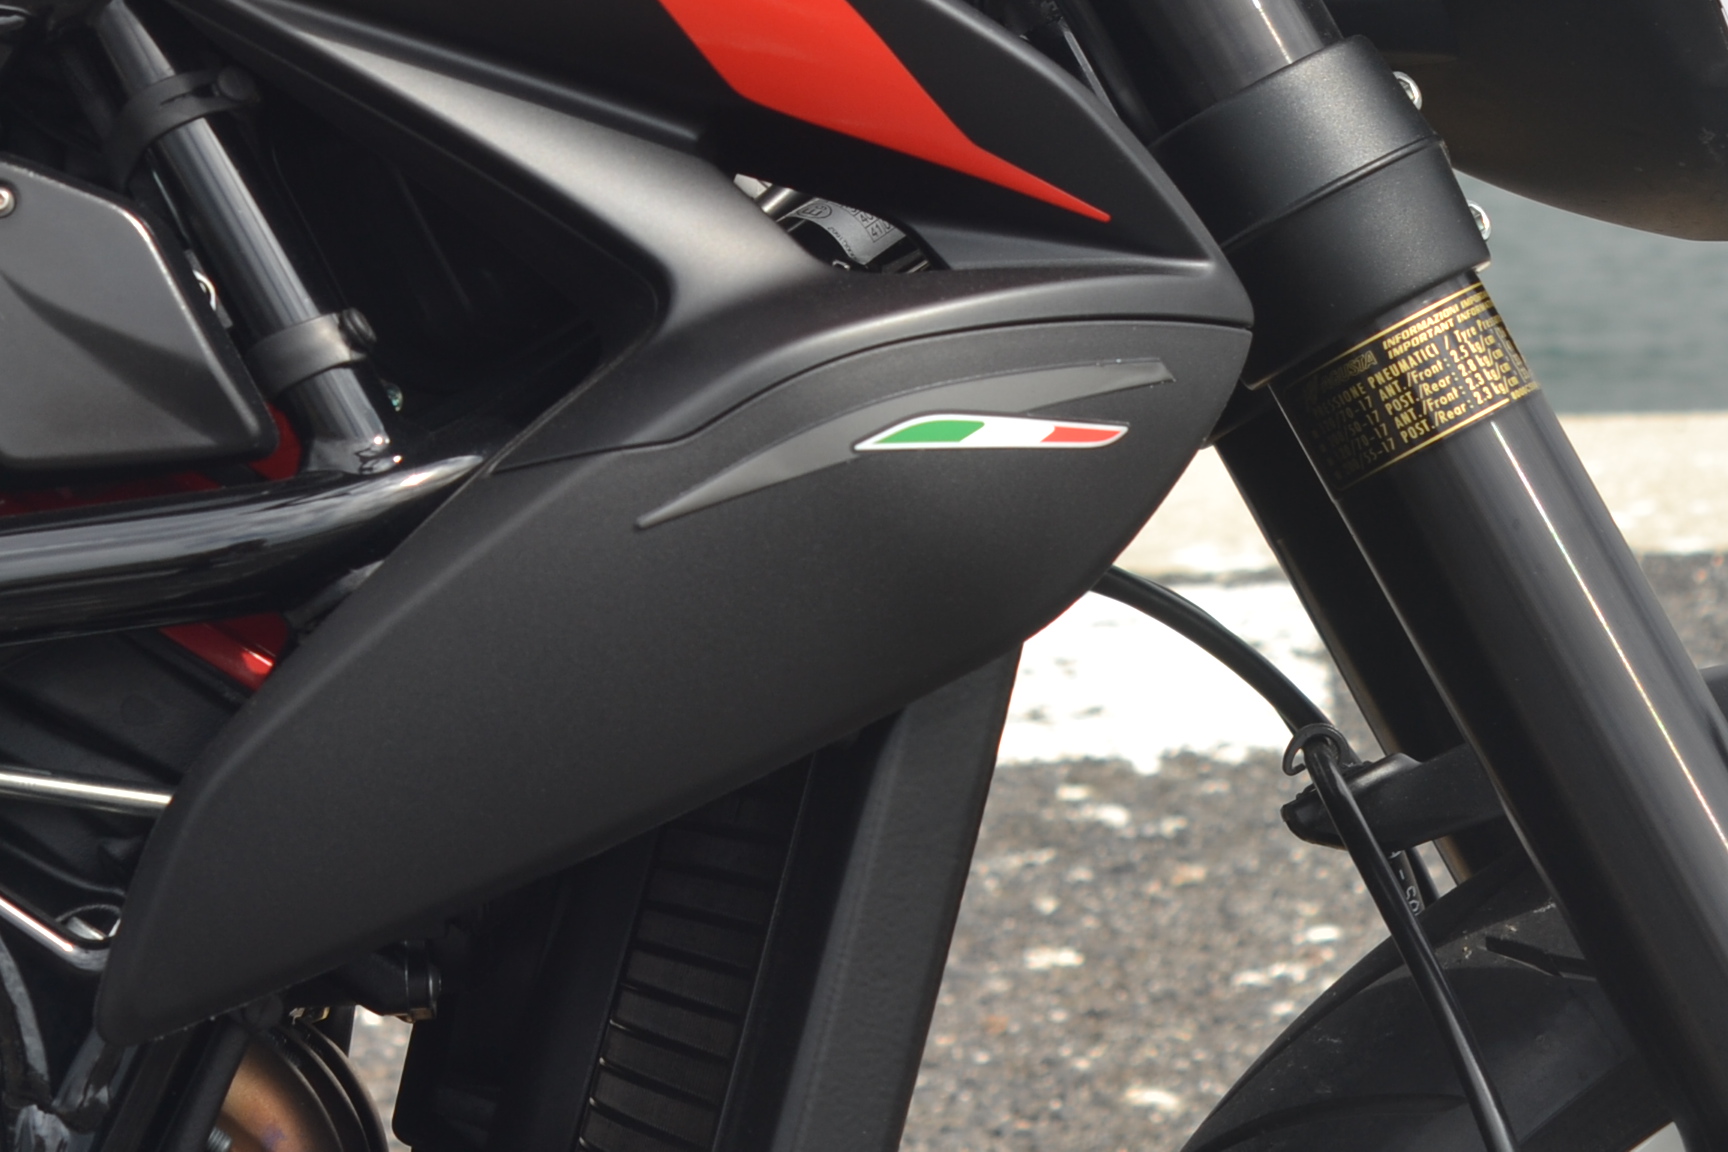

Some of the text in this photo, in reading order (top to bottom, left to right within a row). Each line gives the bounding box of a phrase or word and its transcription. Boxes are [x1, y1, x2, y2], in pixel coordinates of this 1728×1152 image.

[1380, 302, 1460, 350] INFORMAZIONI
[1385, 316, 1456, 360] IMPORTANT
[1364, 341, 1441, 390] PNEUMATICI
[1452, 321, 1480, 346] Tyre
[1447, 342, 1471, 364] 2.5
[1455, 356, 1479, 378] 2.8
[1463, 370, 1486, 392] 2.3
[1471, 384, 1494, 406] 2.3
